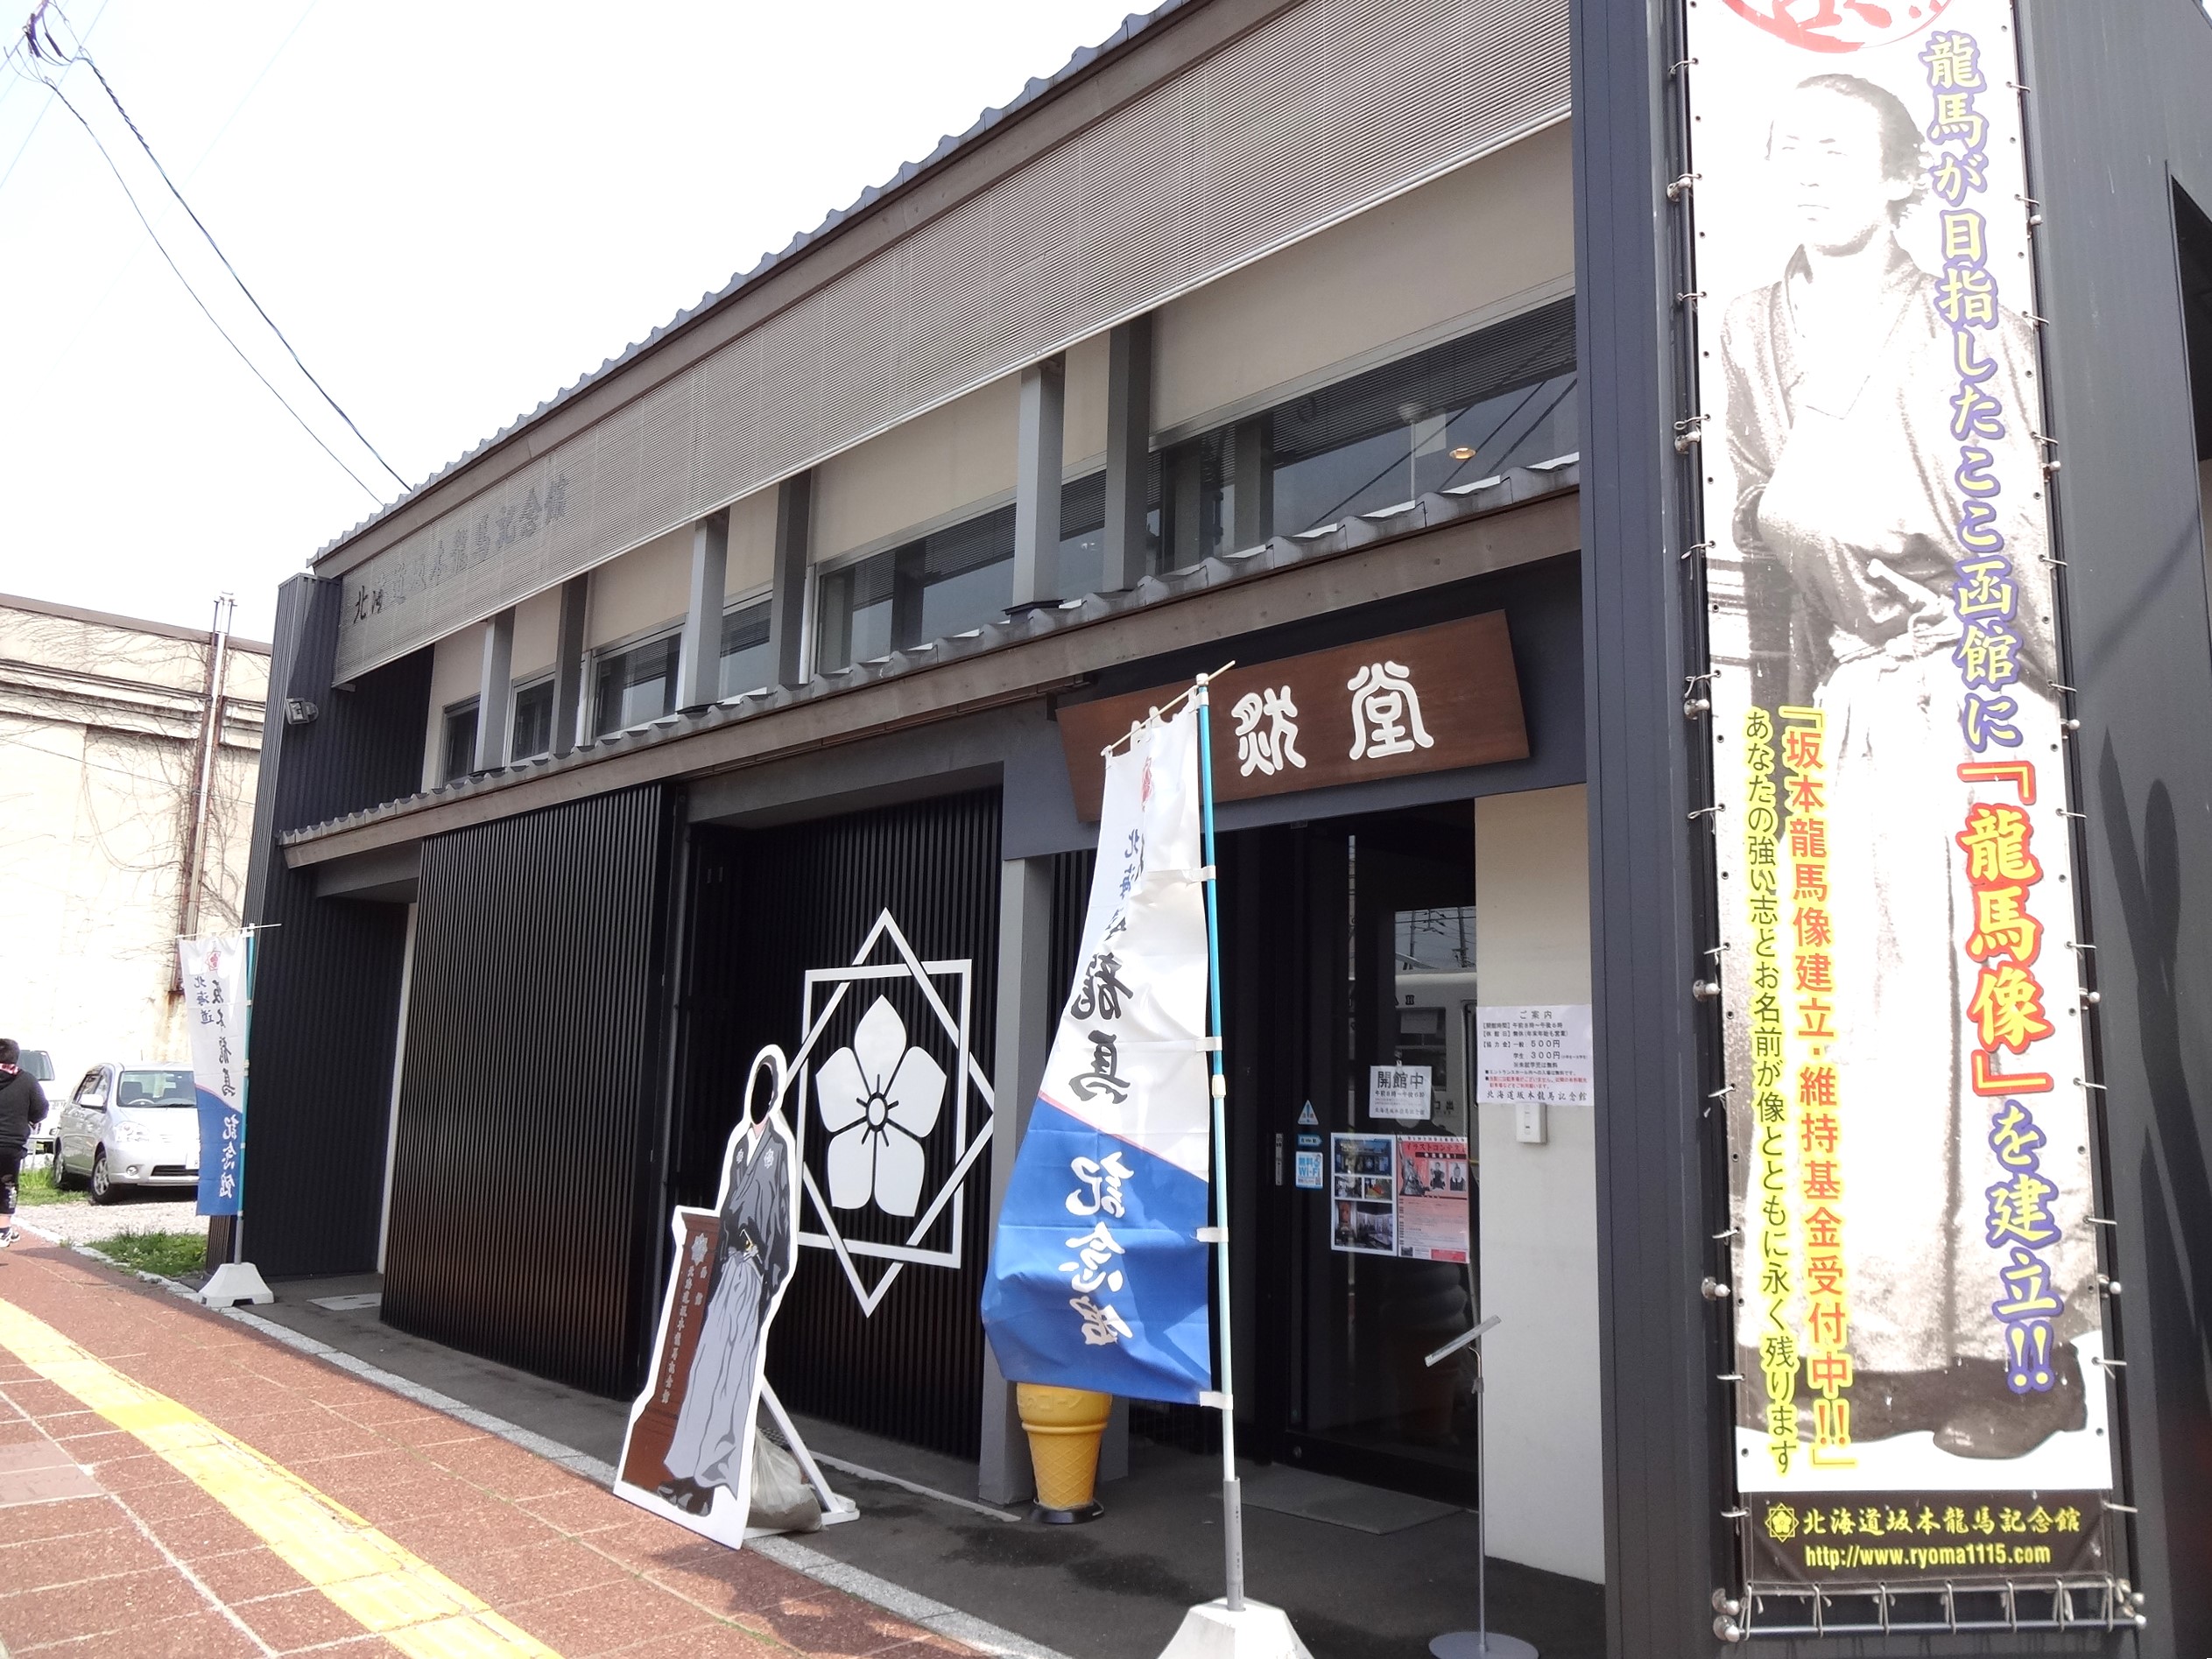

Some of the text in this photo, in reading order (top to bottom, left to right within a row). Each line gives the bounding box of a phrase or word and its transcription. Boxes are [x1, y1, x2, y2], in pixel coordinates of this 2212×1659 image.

[1377, 1070, 1425, 1089] 開館中
[1746, 712, 1797, 1473] あなたの強い志とお名前が像とともに永く残ります
[1802, 1505, 2081, 1536] 北海道坂本龍馬記念館
[1804, 1543, 2052, 1570] http://www.ryoma1115.com
